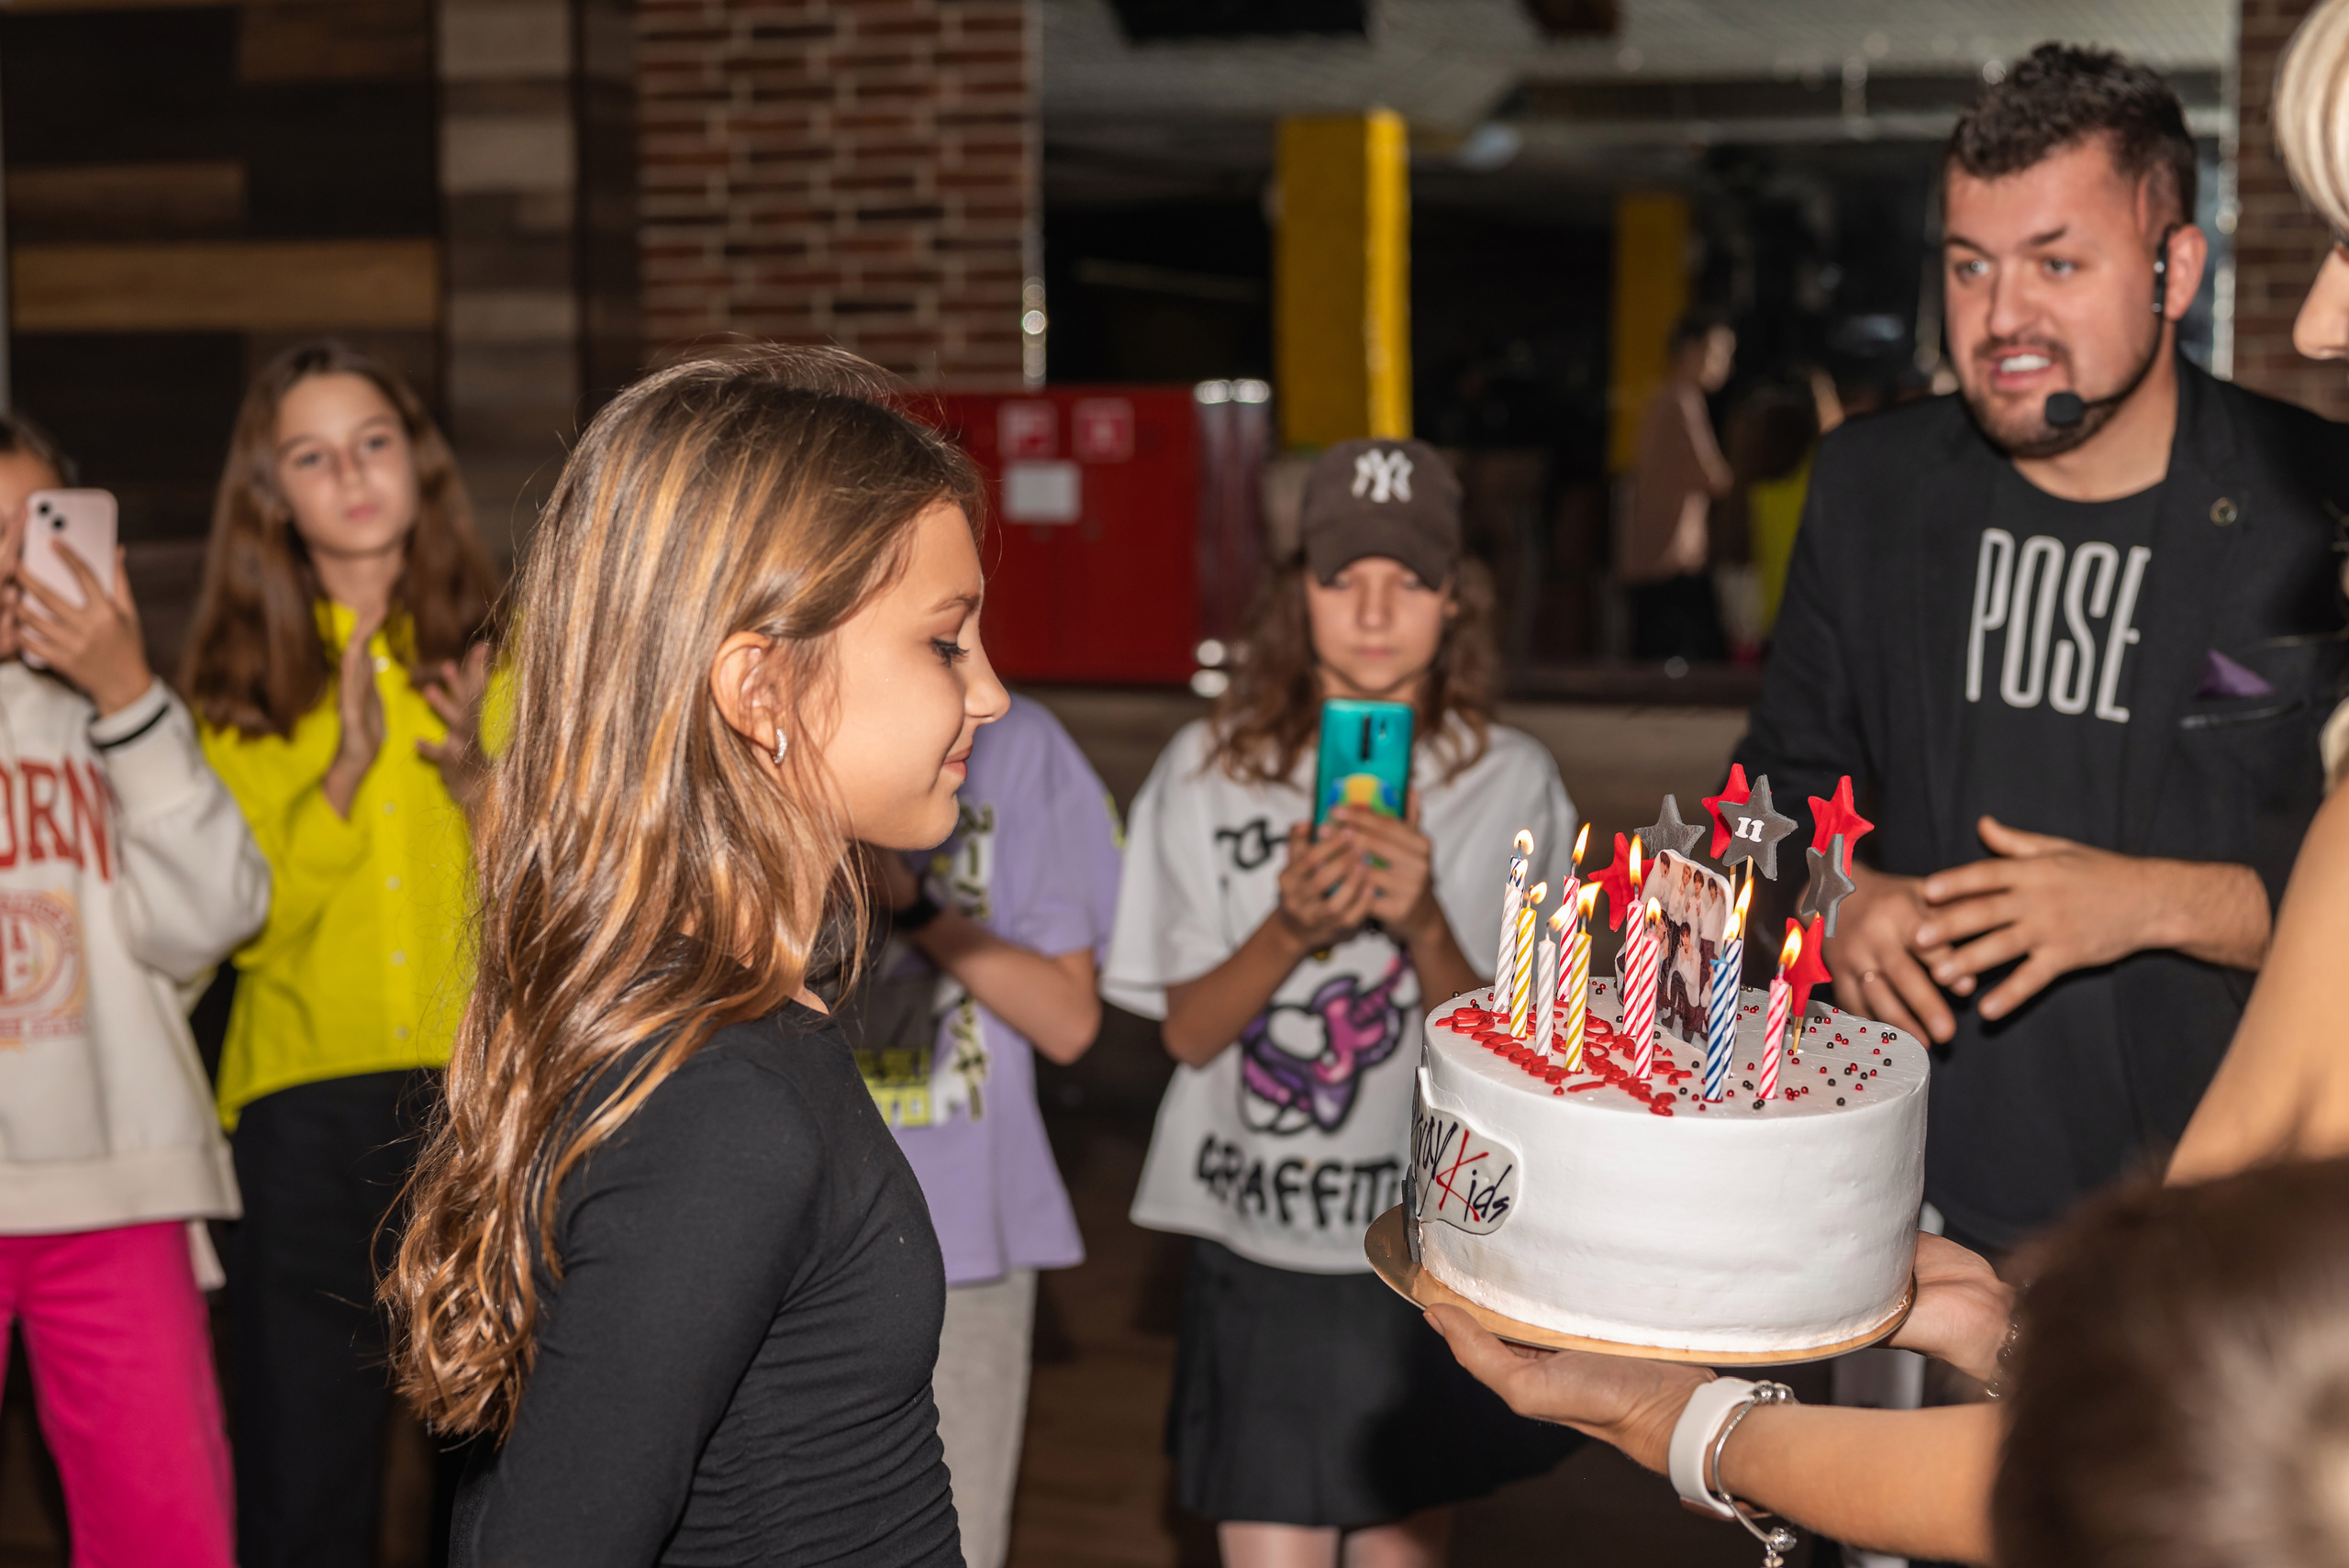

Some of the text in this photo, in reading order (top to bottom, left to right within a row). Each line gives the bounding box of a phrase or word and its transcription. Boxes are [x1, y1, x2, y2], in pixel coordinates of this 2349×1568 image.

[1965, 527, 2153, 724] POSE
[1734, 817, 1765, 843] 11
[1435, 1129, 1513, 1223] Kids
